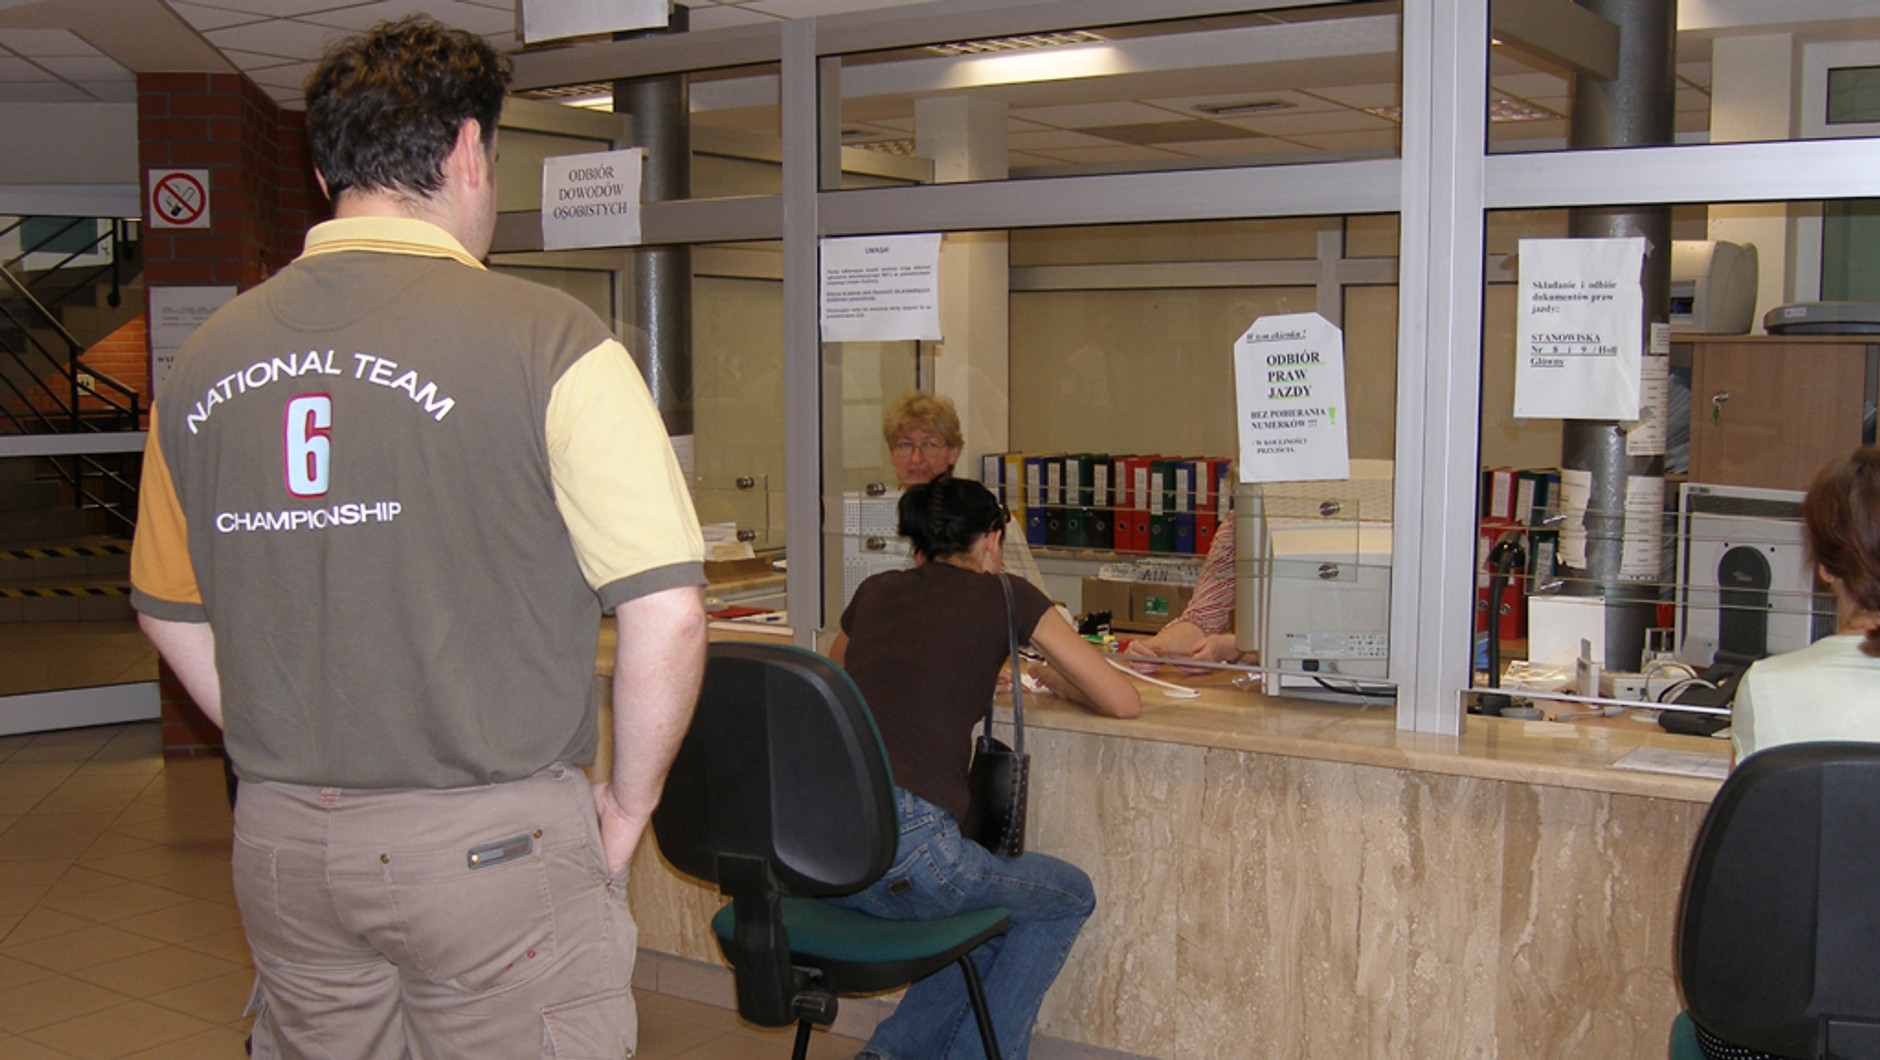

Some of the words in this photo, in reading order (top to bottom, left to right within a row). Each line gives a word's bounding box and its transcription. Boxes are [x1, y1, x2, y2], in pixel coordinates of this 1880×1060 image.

[568, 164, 615, 182] ODBIÓR
[559, 182, 624, 200] DOWODÓW
[553, 202, 628, 219] OSOBISTYCH
[1532, 292, 1589, 301] dokumentów
[1591, 294, 1613, 303] praw
[1531, 334, 1601, 342] STANOWISKA
[1266, 349, 1320, 366] ODBIÓR
[1531, 345, 1543, 354] Nr
[1268, 369, 1308, 382] PRAW
[187, 350, 342, 434] NATIONAL
[354, 353, 456, 421] TEAM
[1268, 385, 1312, 399] JAZDY
[1250, 411, 1268, 420] BEZ
[283, 392, 332, 499] 6
[216, 502, 402, 532] CHAMPIONSHIP
